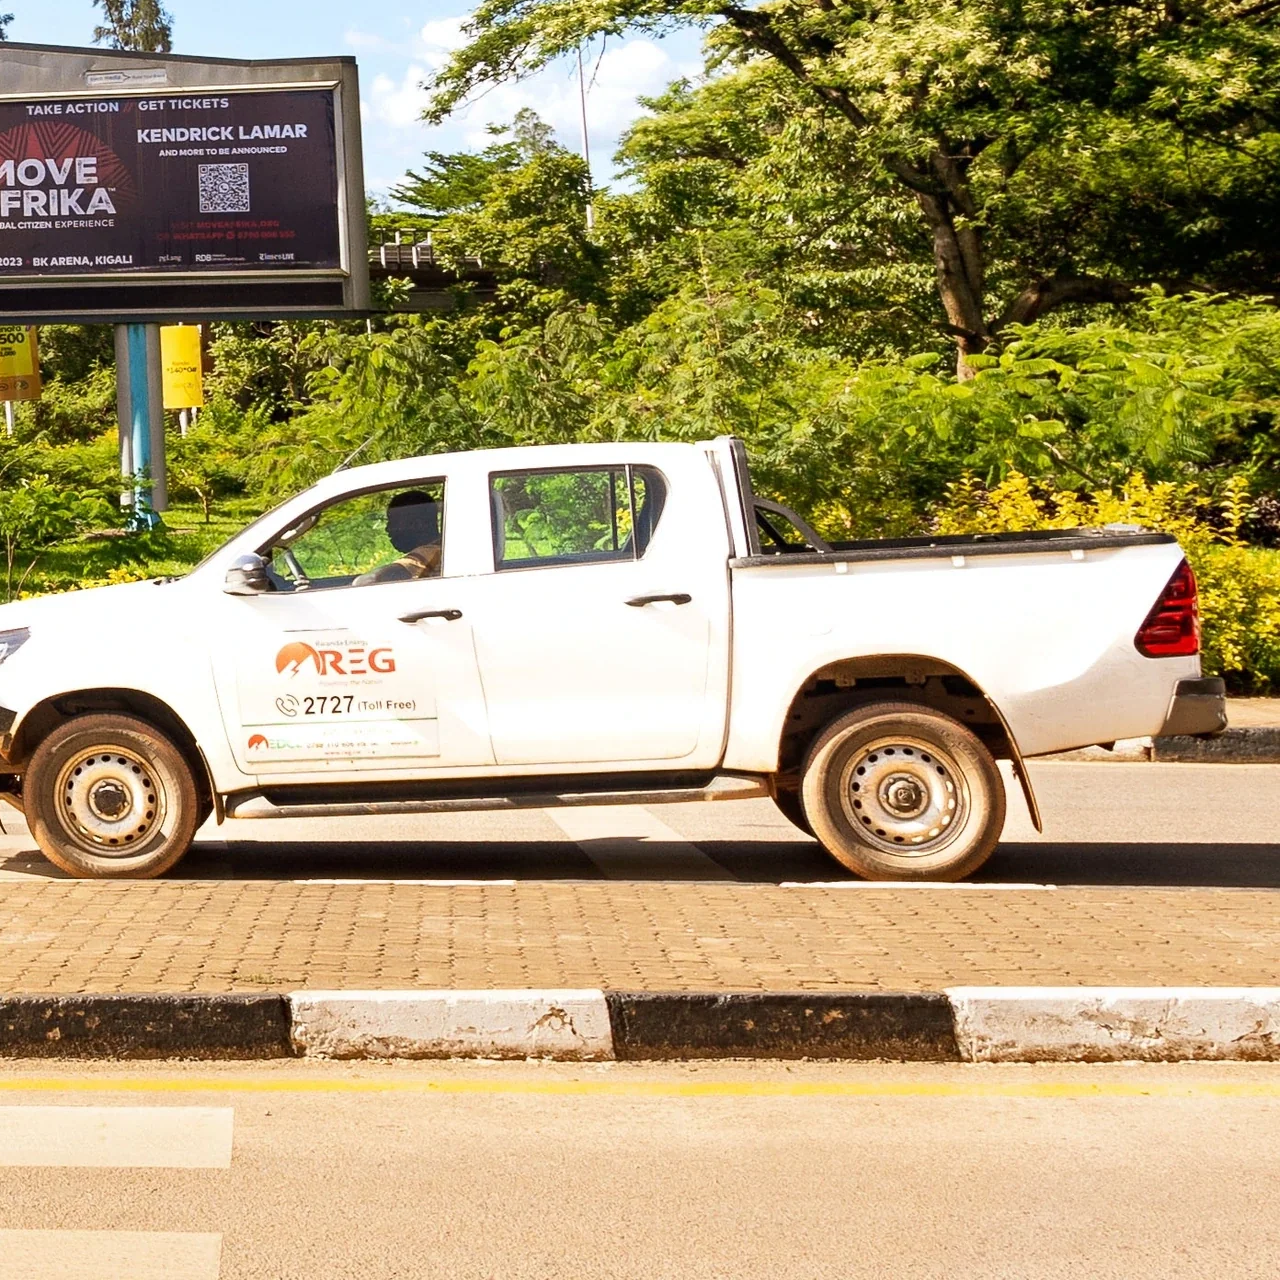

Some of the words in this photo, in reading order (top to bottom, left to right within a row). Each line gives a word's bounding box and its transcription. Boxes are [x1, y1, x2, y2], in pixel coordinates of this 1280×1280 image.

[26, 105, 63, 115] TAKE
[65, 102, 119, 114] ACTION
[138, 100, 166, 111] GET
[169, 98, 229, 110] TICKETS
[137, 126, 234, 143] KENDRICK
[239, 124, 308, 140] LAMAR
[231, 146, 288, 155] ANNOUNCED
[18, 221, 52, 229] CITIZEN
[55, 219, 115, 228] EXPERIENCE
[33, 257, 48, 267] BK
[51, 256, 93, 267] ARENA,
[95, 255, 133, 265] KIGALI
[318, 648, 396, 676] REG
[303, 695, 354, 715] 2727
[358, 700, 382, 712] (Toll
[386, 699, 416, 711] Free)
